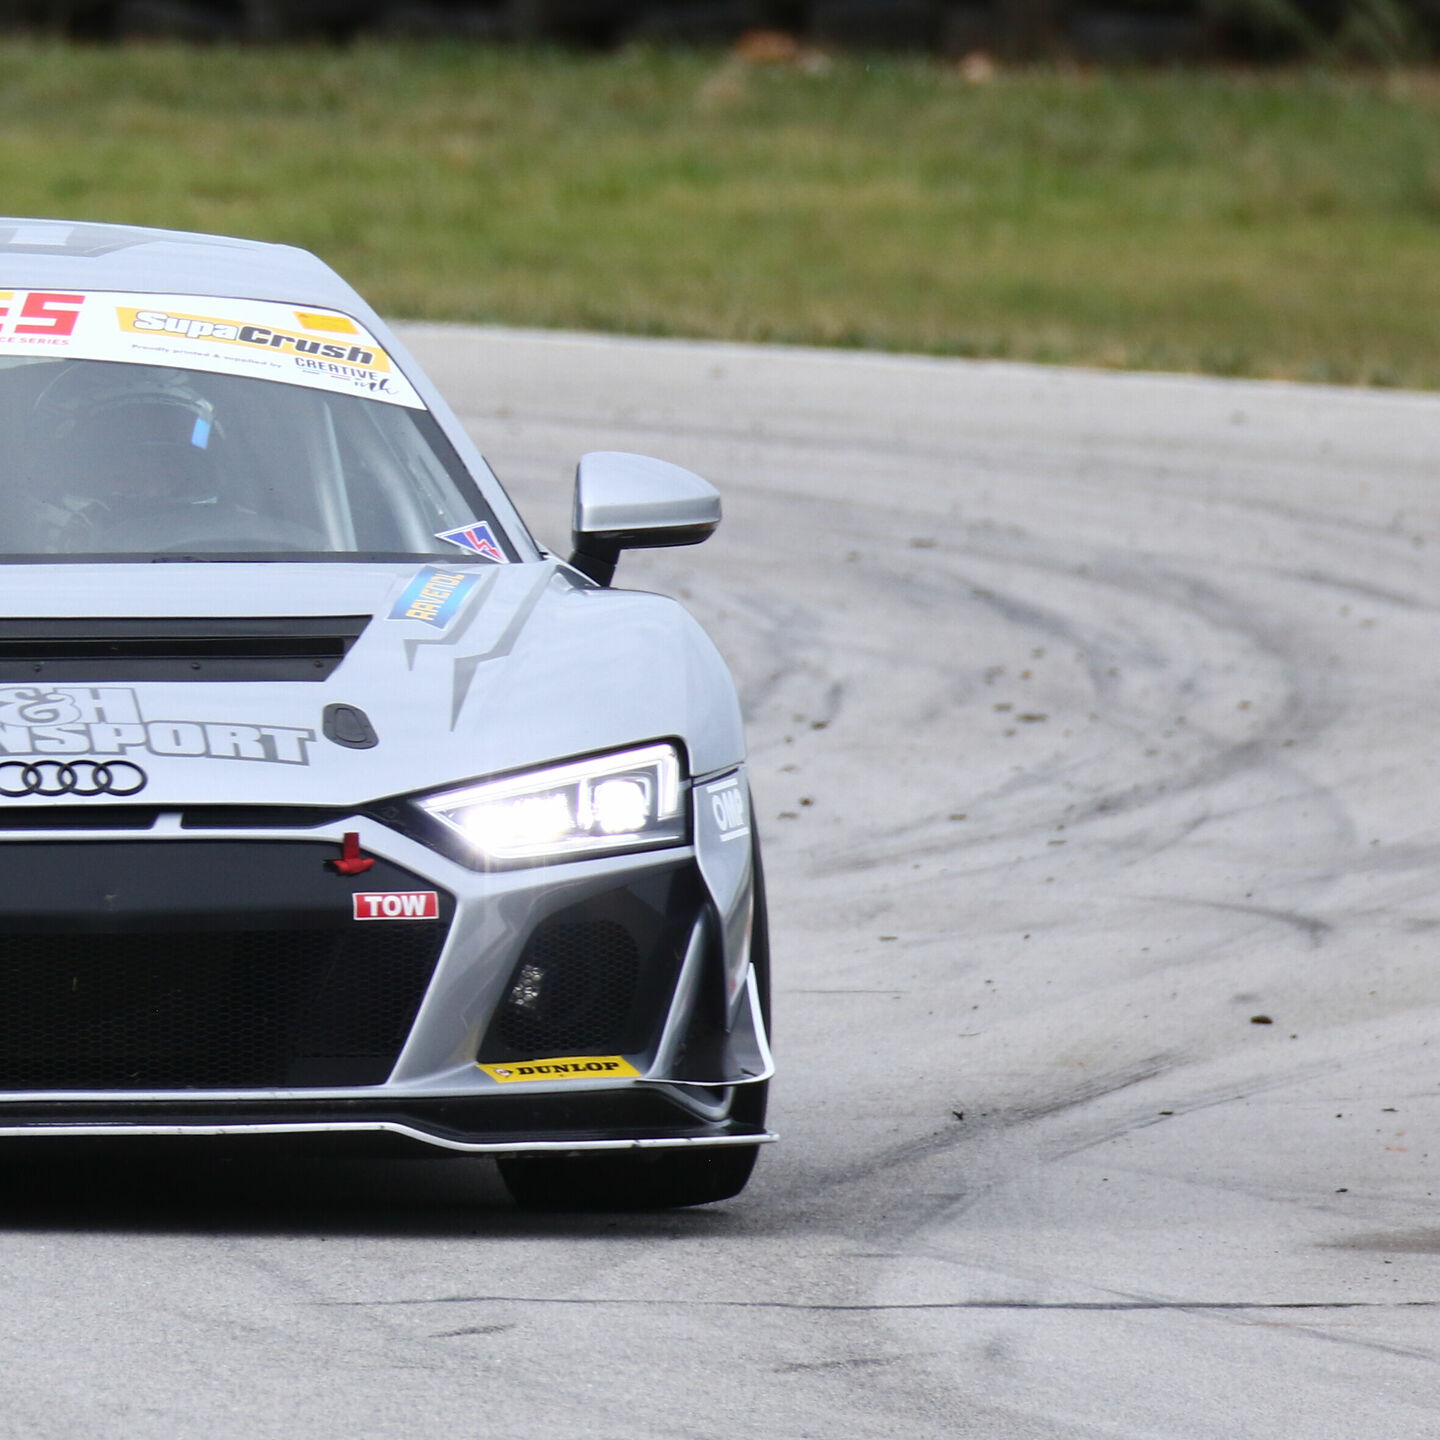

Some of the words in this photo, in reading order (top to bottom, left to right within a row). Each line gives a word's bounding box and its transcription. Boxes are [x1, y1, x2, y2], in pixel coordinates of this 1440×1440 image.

[19, 337, 70, 346] SERIES
[294, 357, 378, 381] CREATIVE
[406, 571, 465, 621] RAVENOL
[364, 895, 426, 917] TOW
[518, 1062, 620, 1076] DUNLOP
